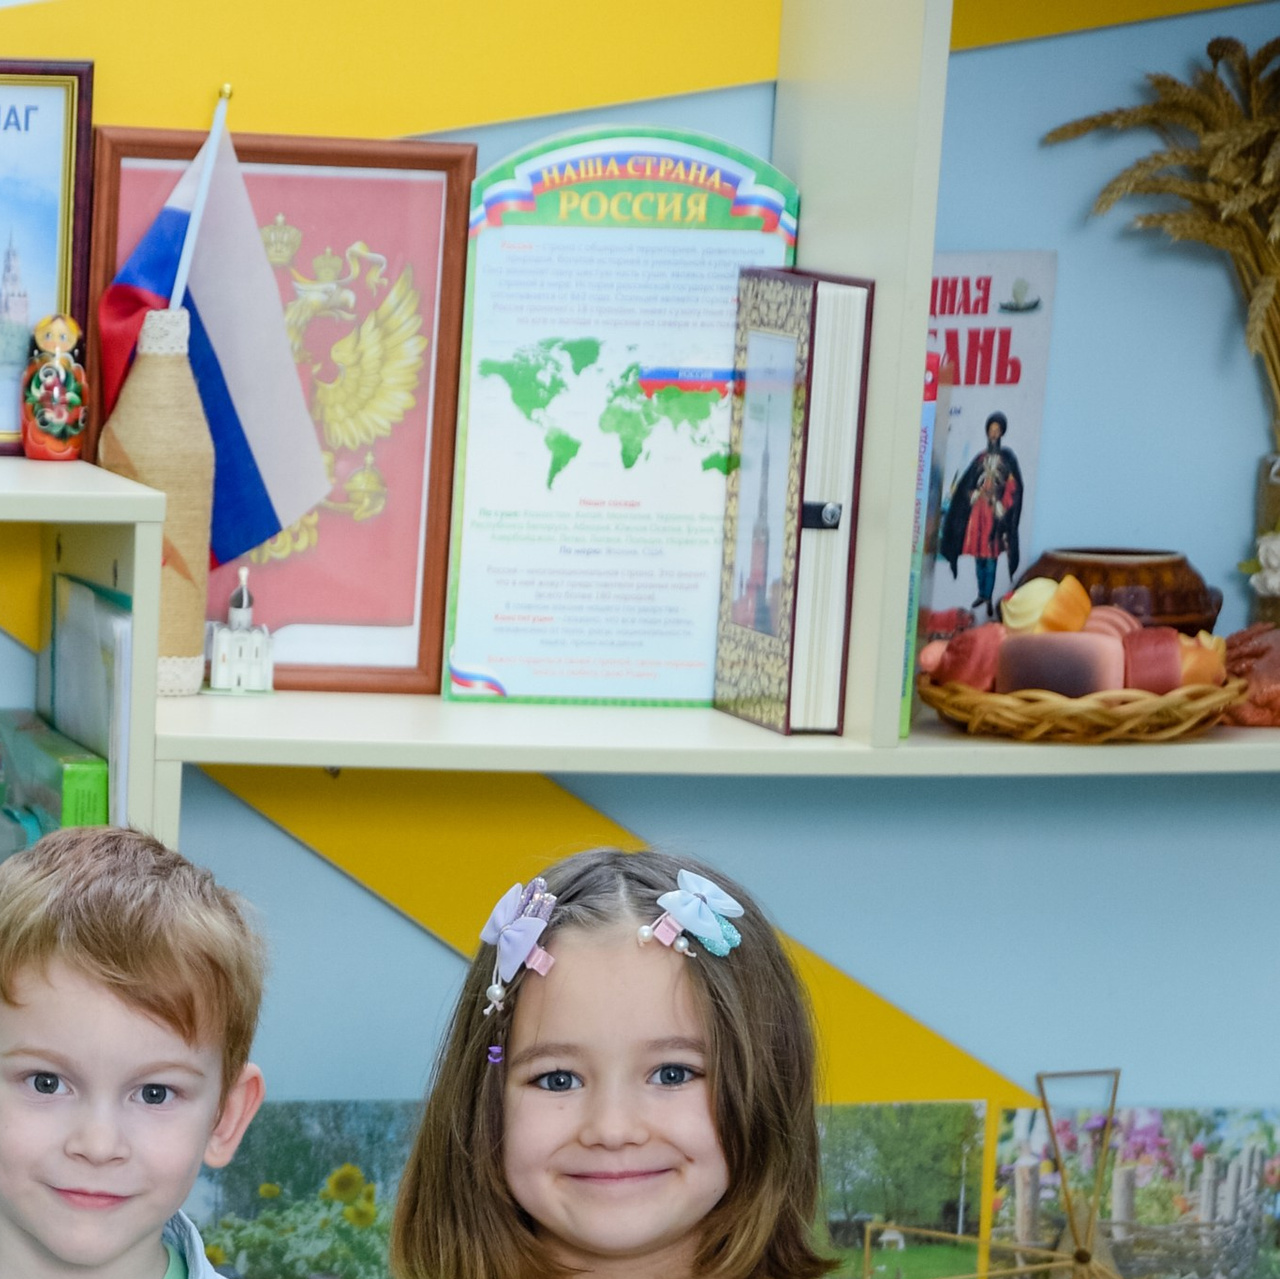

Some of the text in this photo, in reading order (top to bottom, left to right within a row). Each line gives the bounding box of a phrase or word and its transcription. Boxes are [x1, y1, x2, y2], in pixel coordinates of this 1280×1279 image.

[540, 156, 620, 188] НАША
[558, 190, 709, 223] РОССИЯ
[928, 327, 1022, 385] АНЬ
